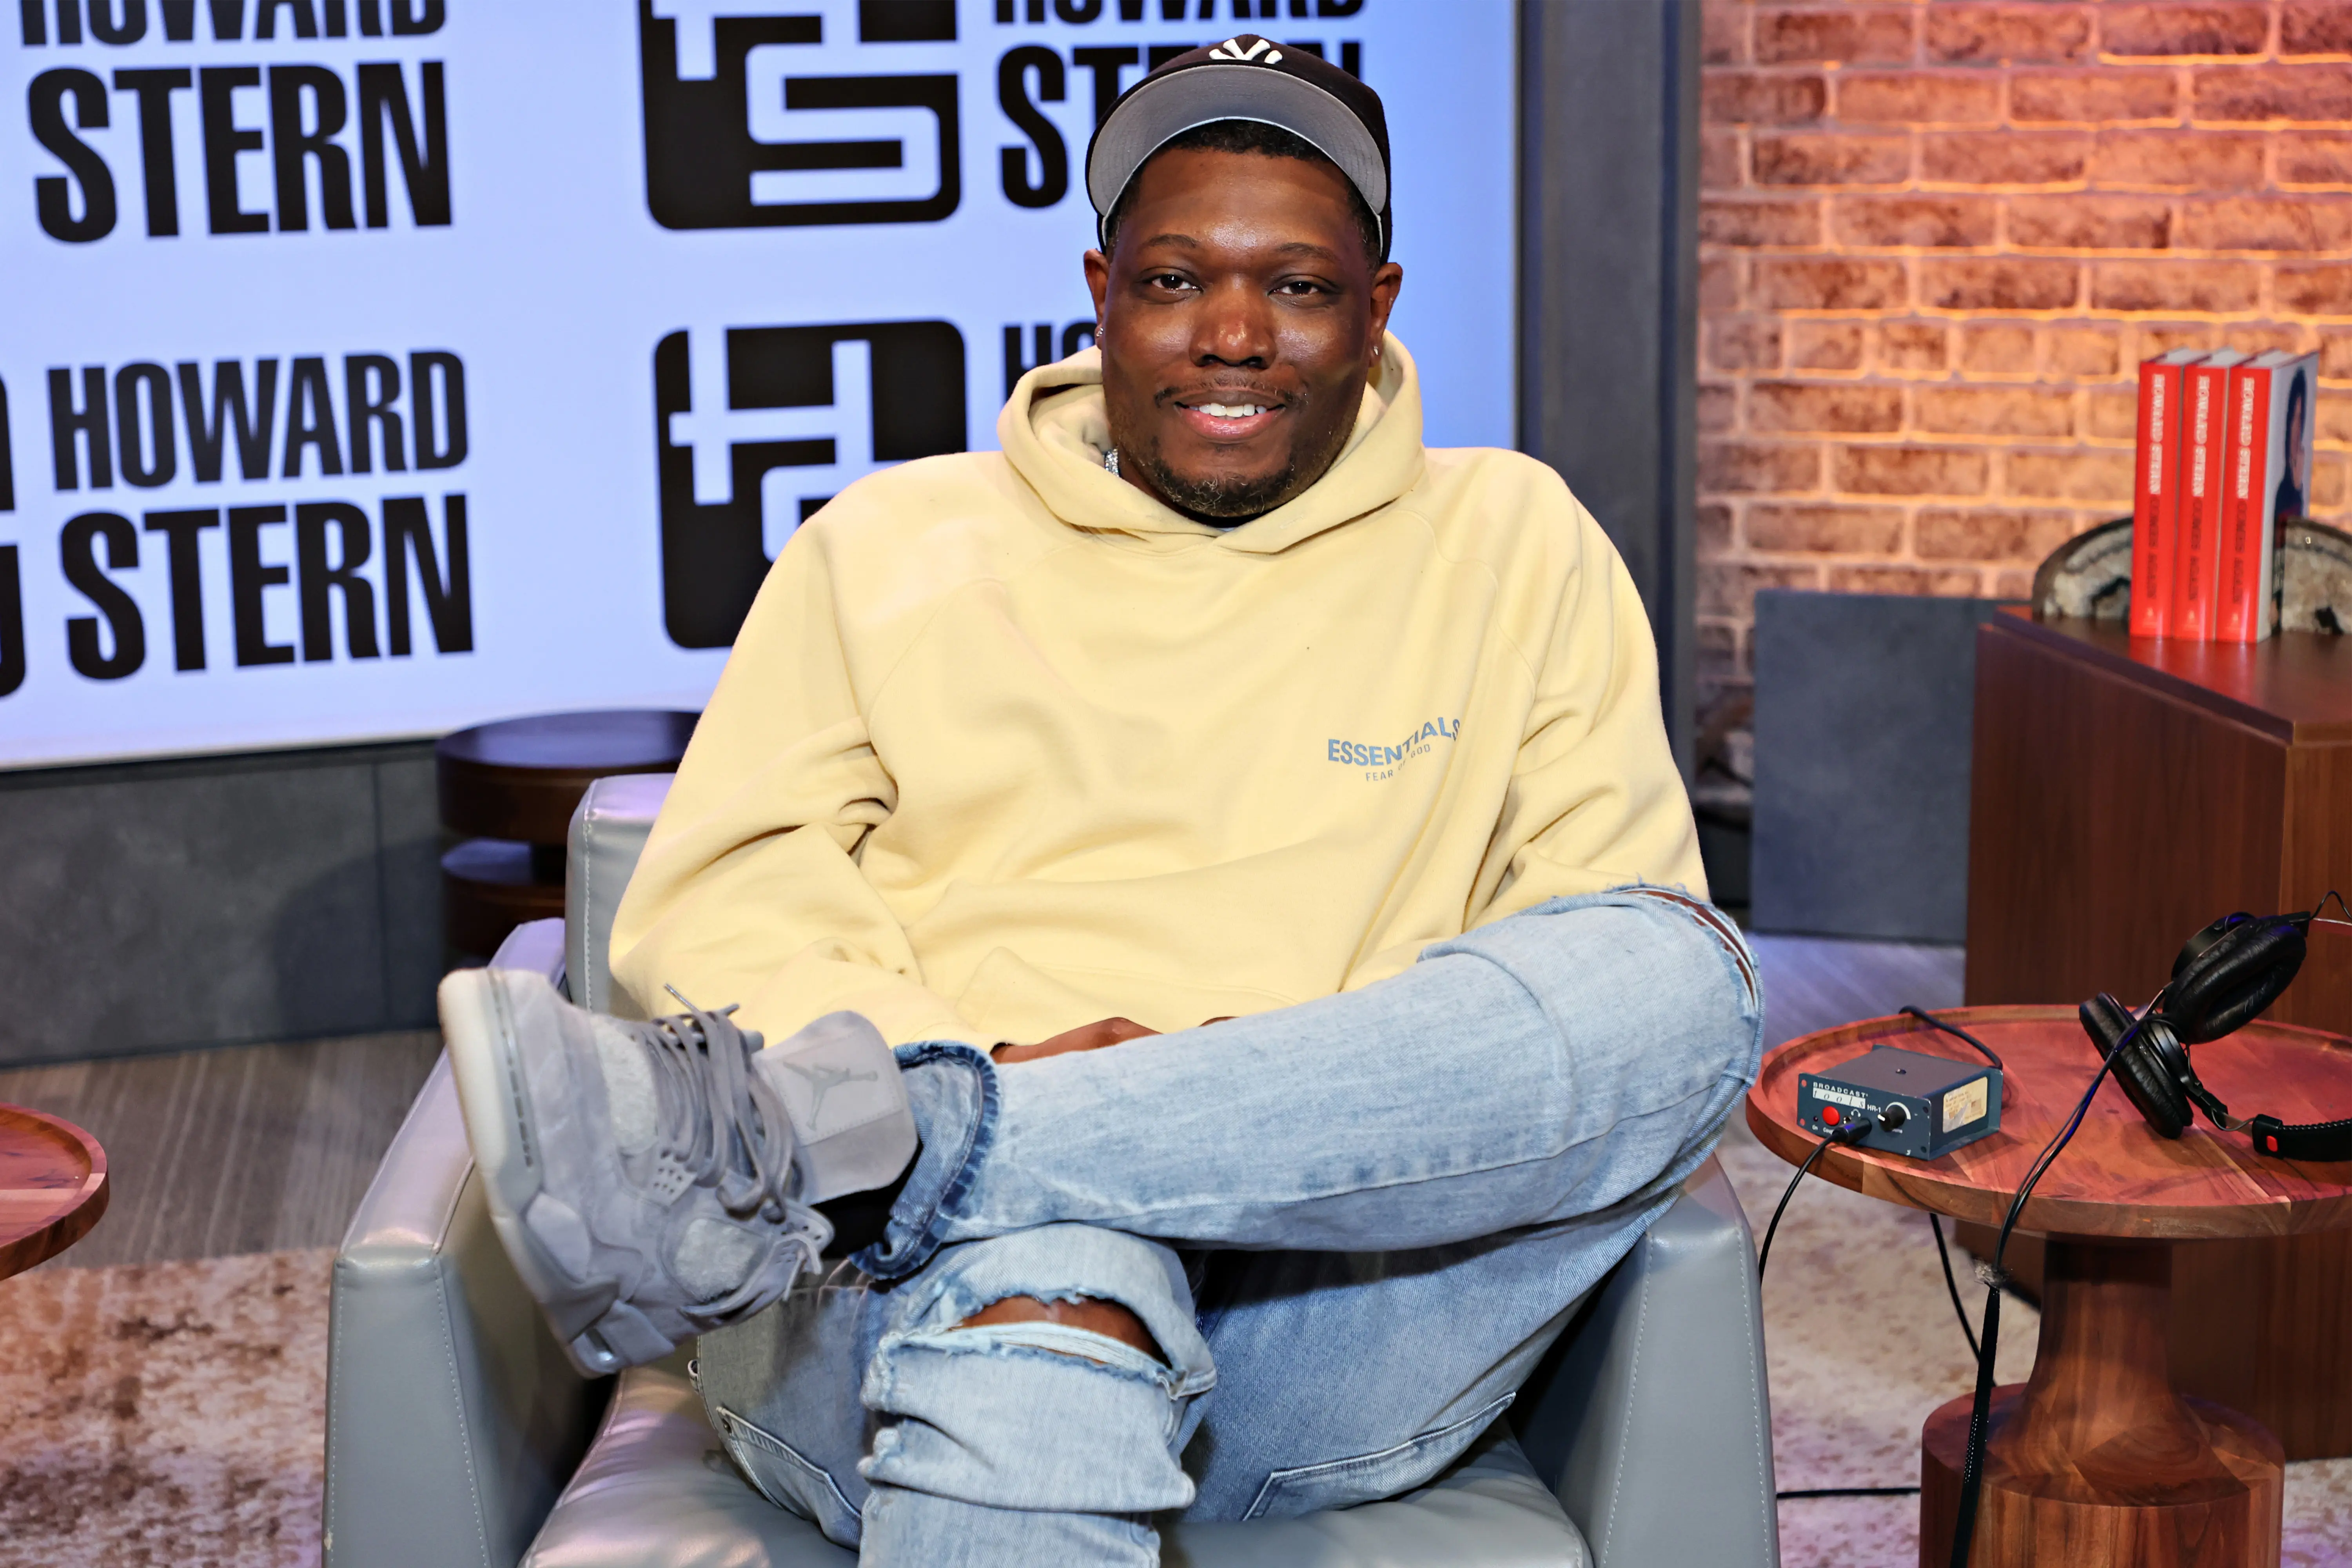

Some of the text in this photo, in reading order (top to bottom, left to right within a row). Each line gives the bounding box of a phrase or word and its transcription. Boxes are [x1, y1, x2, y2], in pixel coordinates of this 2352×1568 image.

[27, 60, 453, 244] STERN
[46, 350, 469, 492] HOWARD
[57, 492, 475, 682] STERN
[1328, 717, 1460, 767] ESSENTIALS
[1366, 769, 1394, 782] FEAR
[1410, 744, 1431, 759] GOD
[1813, 1090, 1865, 1109] tools
[1867, 1104, 1881, 1113] HR-1
